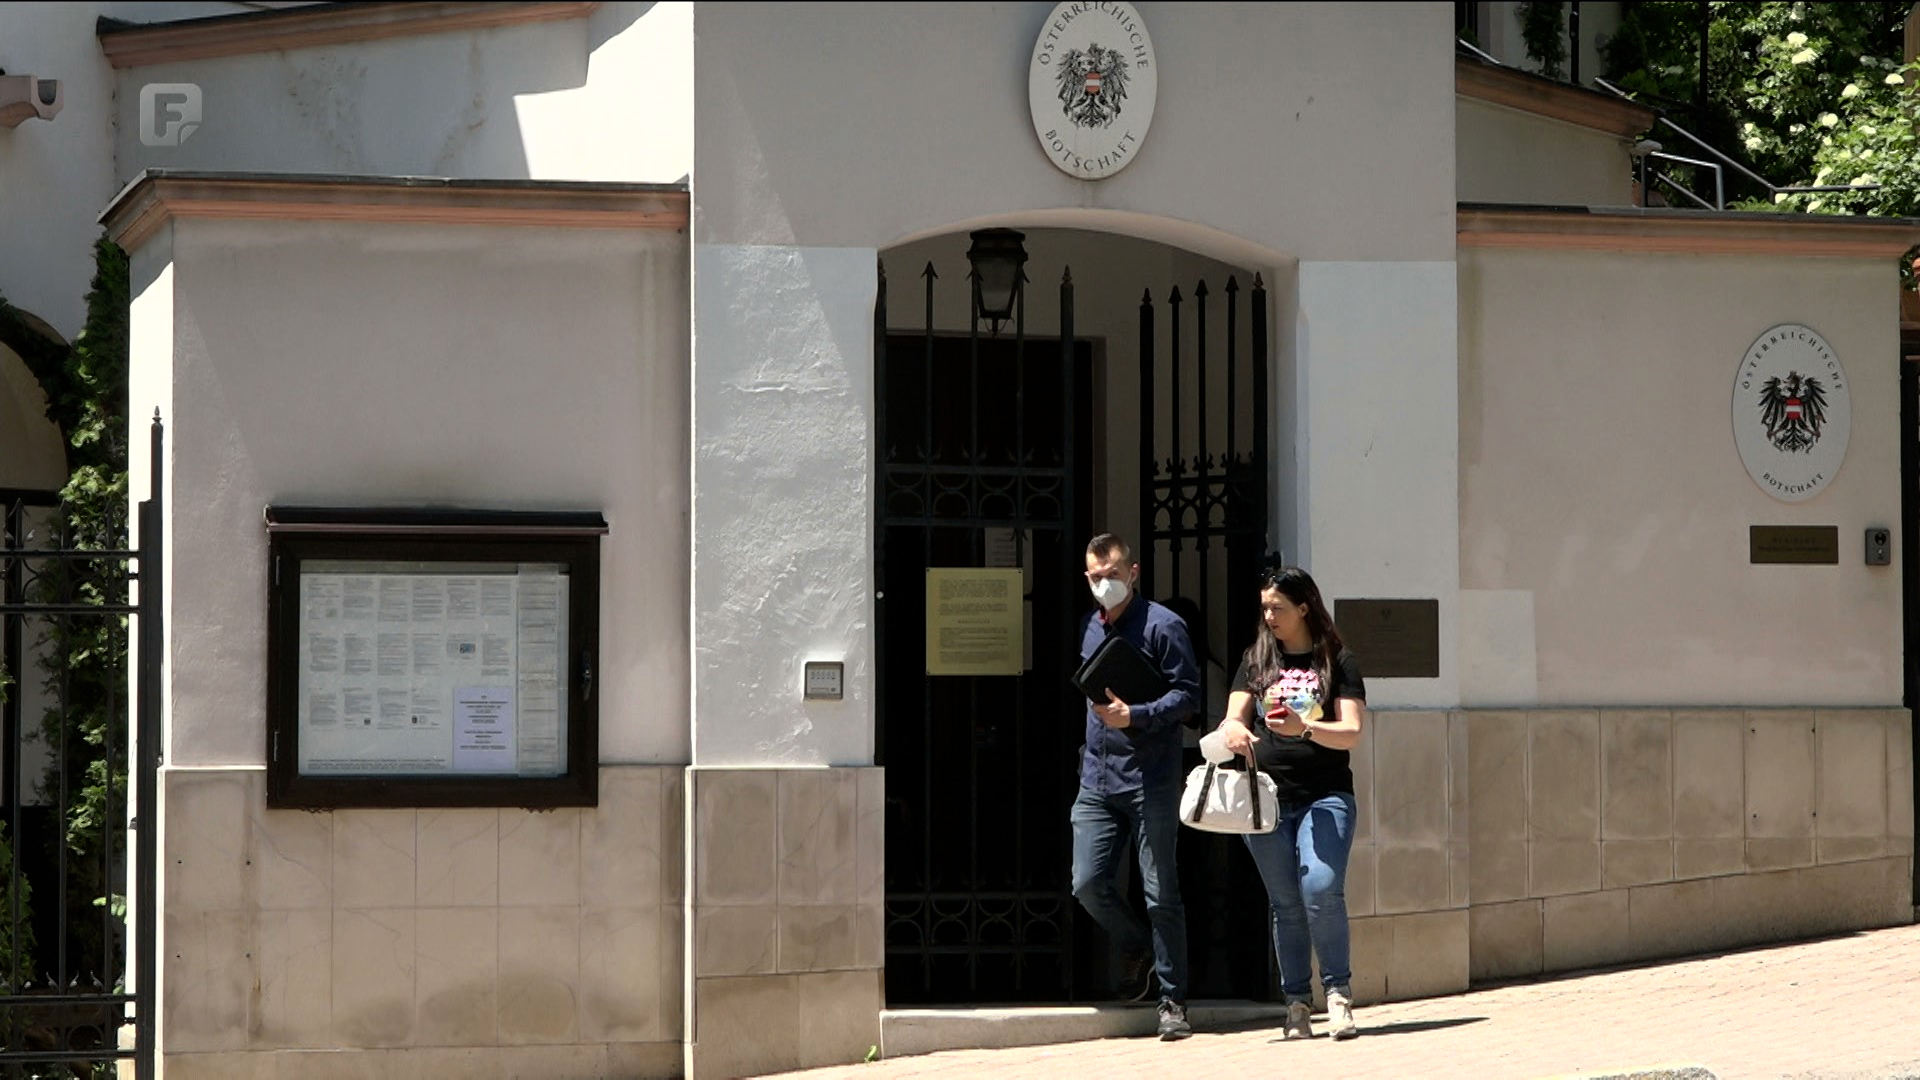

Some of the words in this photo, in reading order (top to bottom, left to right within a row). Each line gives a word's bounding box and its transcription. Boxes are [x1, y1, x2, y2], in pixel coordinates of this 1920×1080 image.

[1037, 1, 1148, 69] ÖSTERREICHISCHE
[1045, 129, 1136, 172] BOTSCHAFT
[1741, 331, 1842, 391] ÖSTERREICHISCHE
[1762, 471, 1824, 494] BOTSCHAFT
